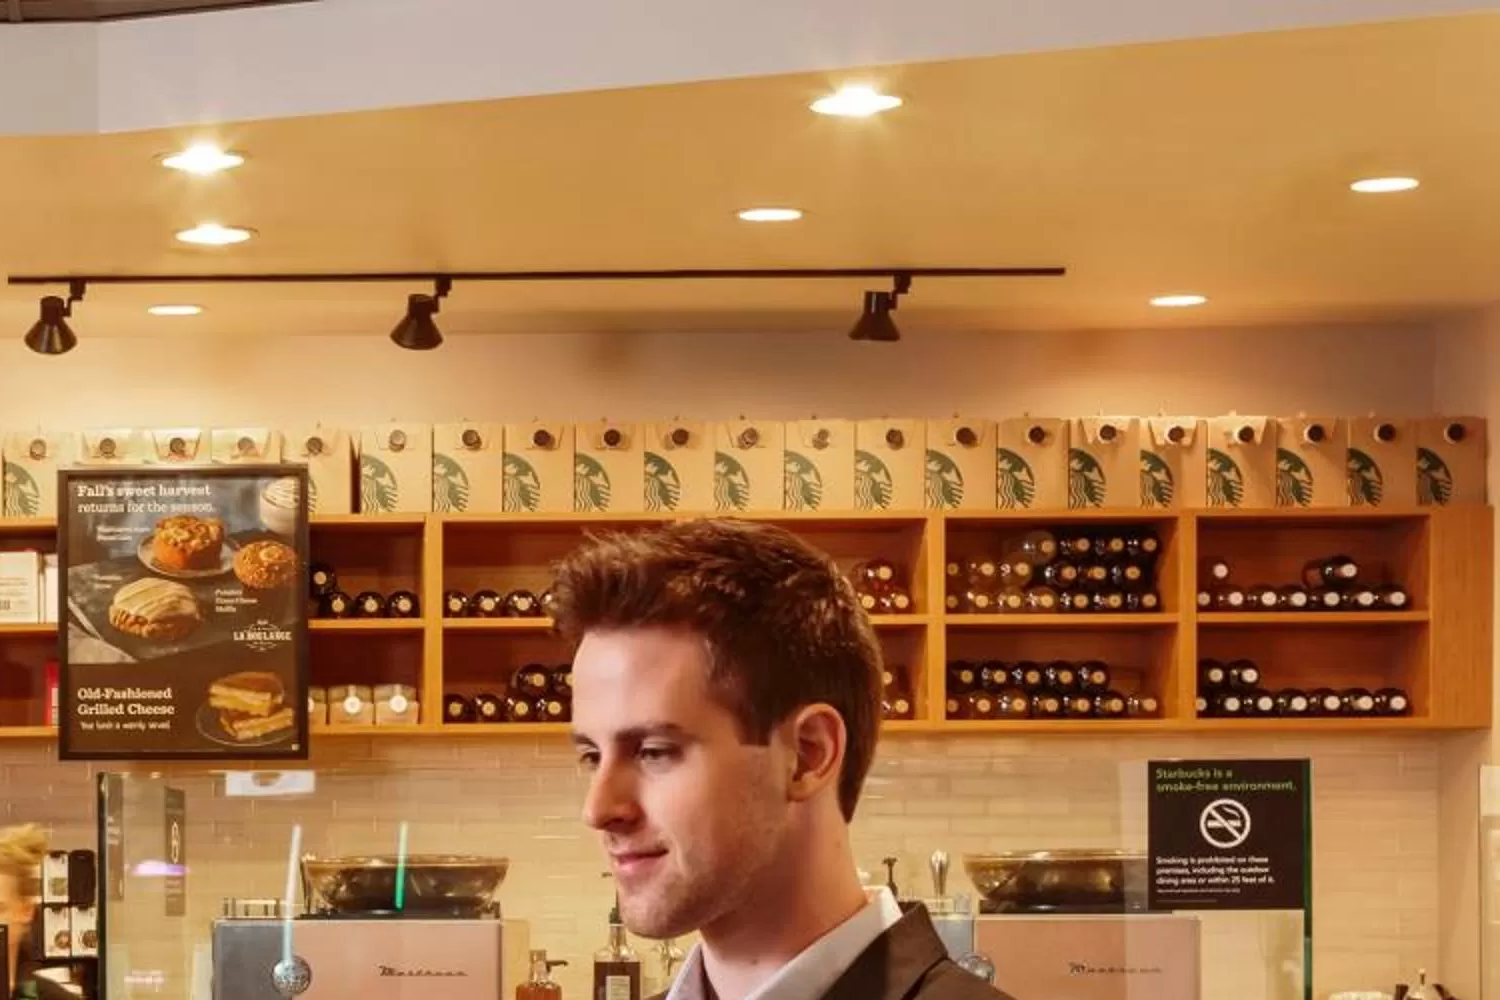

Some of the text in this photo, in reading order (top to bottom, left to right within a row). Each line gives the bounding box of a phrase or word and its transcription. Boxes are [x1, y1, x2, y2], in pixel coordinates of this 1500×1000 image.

[77, 484, 212, 497] Fall's sweet harvest
[78, 501, 123, 513] returns
[127, 501, 143, 513] for
[147, 501, 166, 513] the
[77, 688, 172, 699] Old-Fashioned
[78, 703, 175, 715] Grilled Cheese
[1155, 769, 1211, 779] Starbucks
[1213, 769, 1223, 779] is
[1155, 781, 1296, 793] smoke-free environment.
[1155, 856, 1188, 865] Smoking
[1198, 856, 1235, 865] prohibited
[1192, 867, 1225, 875] including
[1155, 877, 1178, 886] dining
